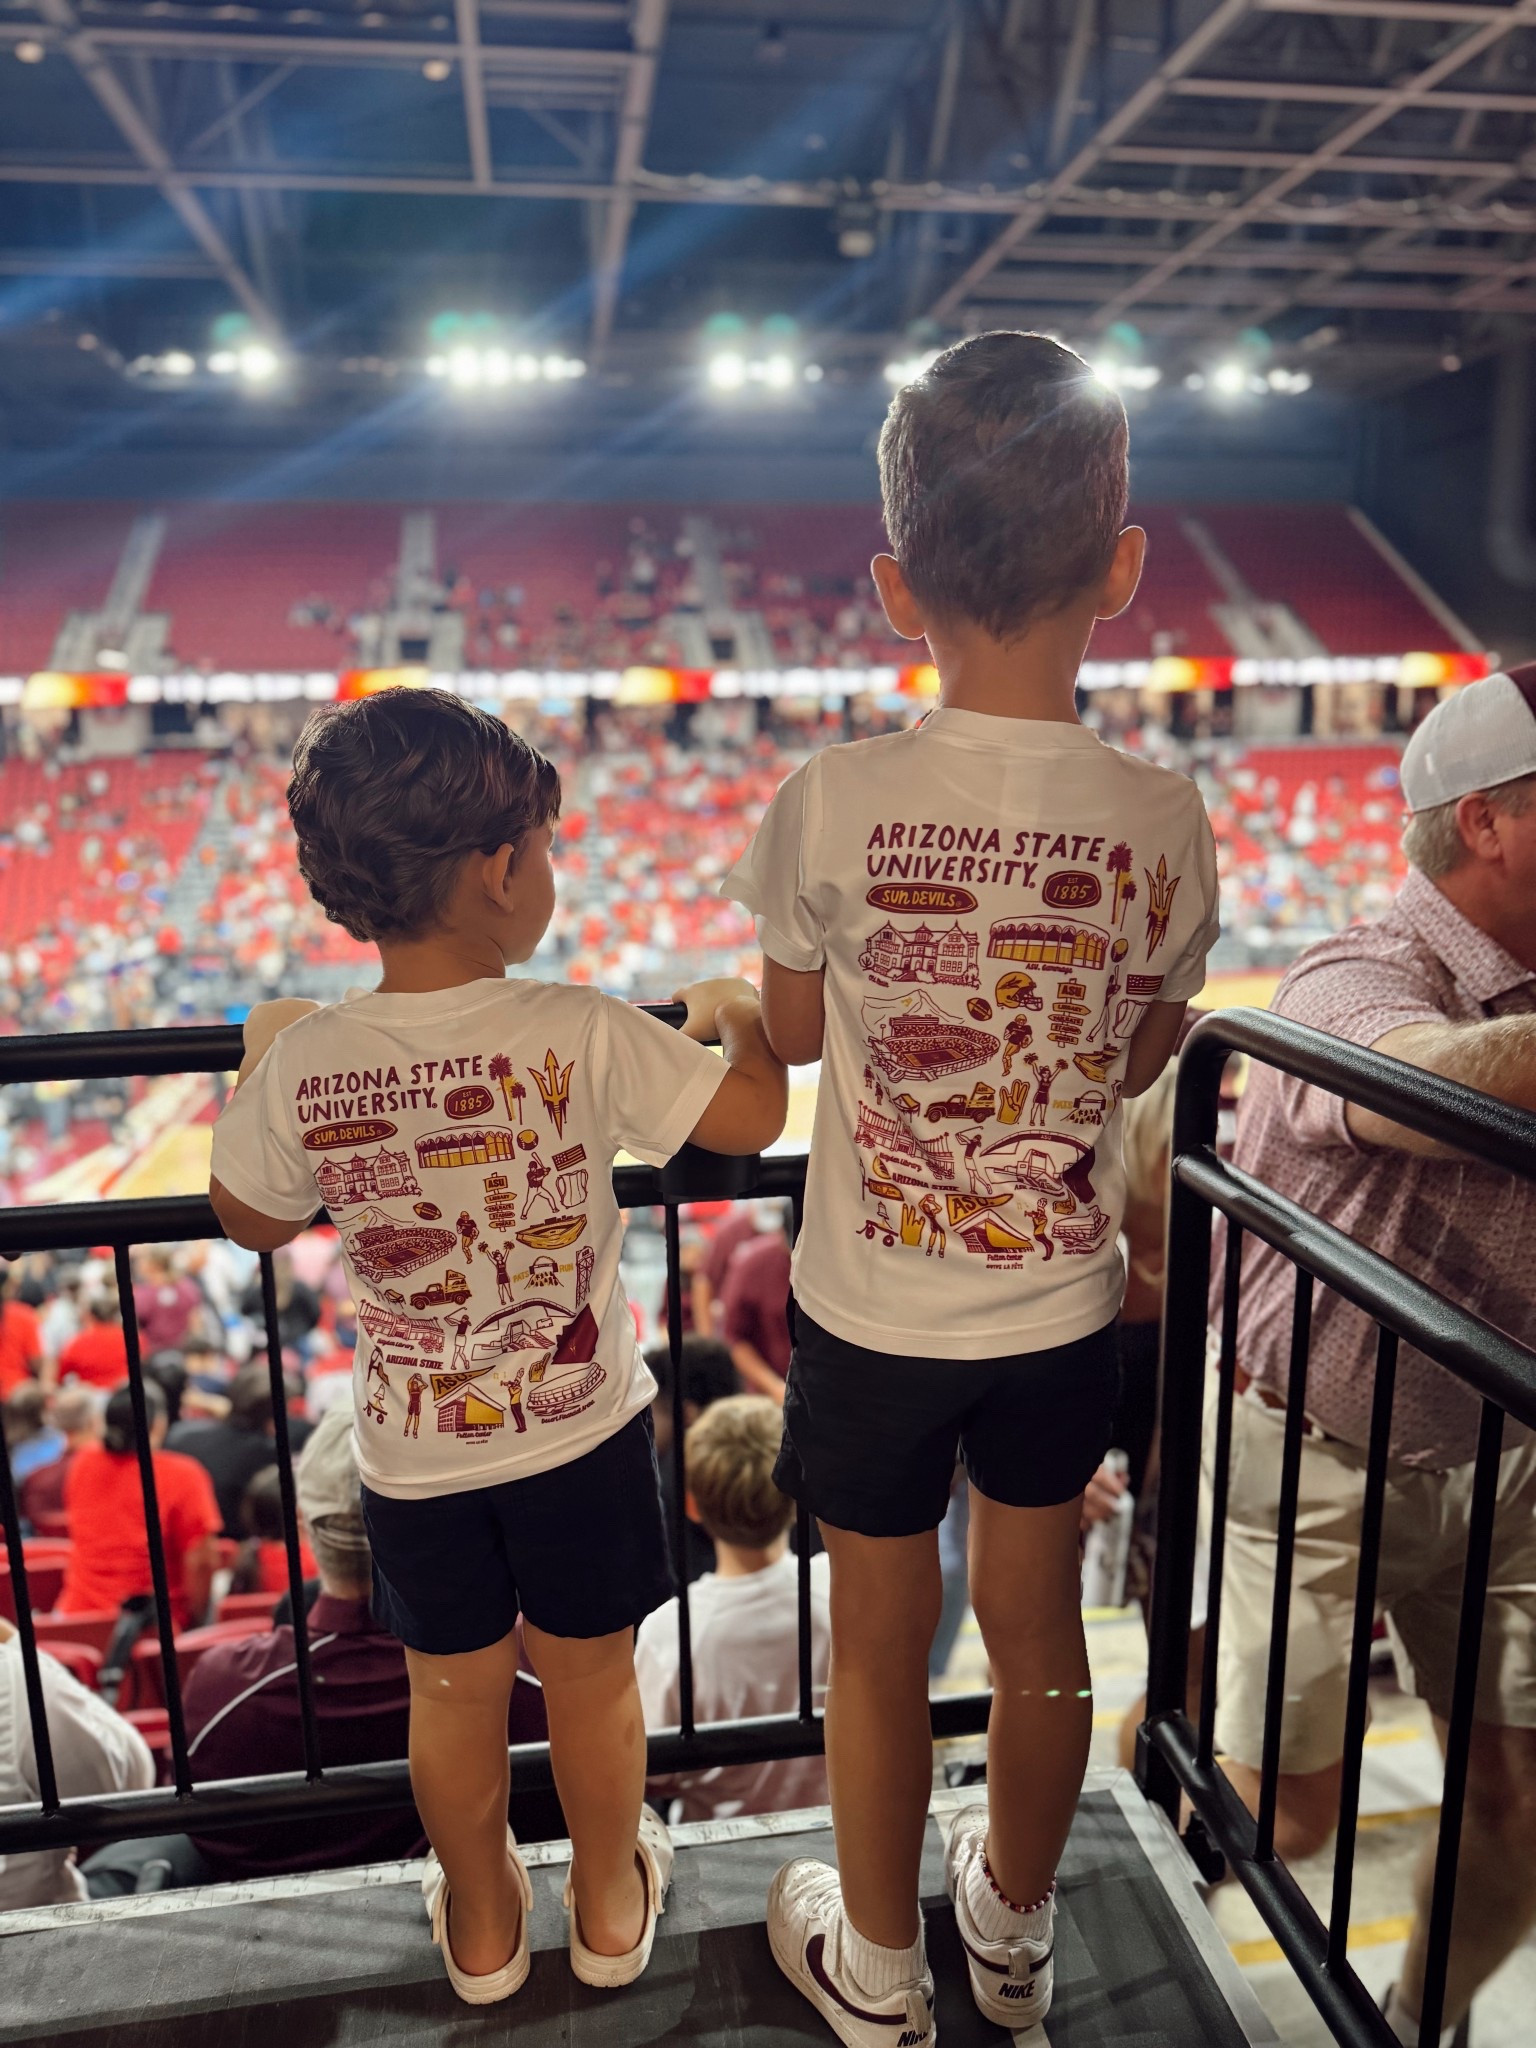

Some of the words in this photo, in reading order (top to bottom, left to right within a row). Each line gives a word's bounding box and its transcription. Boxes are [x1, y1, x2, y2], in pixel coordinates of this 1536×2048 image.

[867, 823, 1000, 852] ARIZONA
[1013, 831, 1105, 862] STATE
[911, 890, 956, 907] DEVILS
[1053, 885, 1092, 899] 1885
[1061, 985, 1082, 997] ASU
[296, 1066, 400, 1101] ARIZONA
[411, 1055, 483, 1084] STATE
[455, 1095, 484, 1112] 1885
[340, 1125, 376, 1140] DEVILS
[488, 1179, 505, 1189] ASU
[559, 1263, 574, 1273] RUN
[386, 1354, 419, 1367] ARIZONA
[419, 1359, 444, 1370] STATE
[998, 1979, 1035, 1999] NIKE
